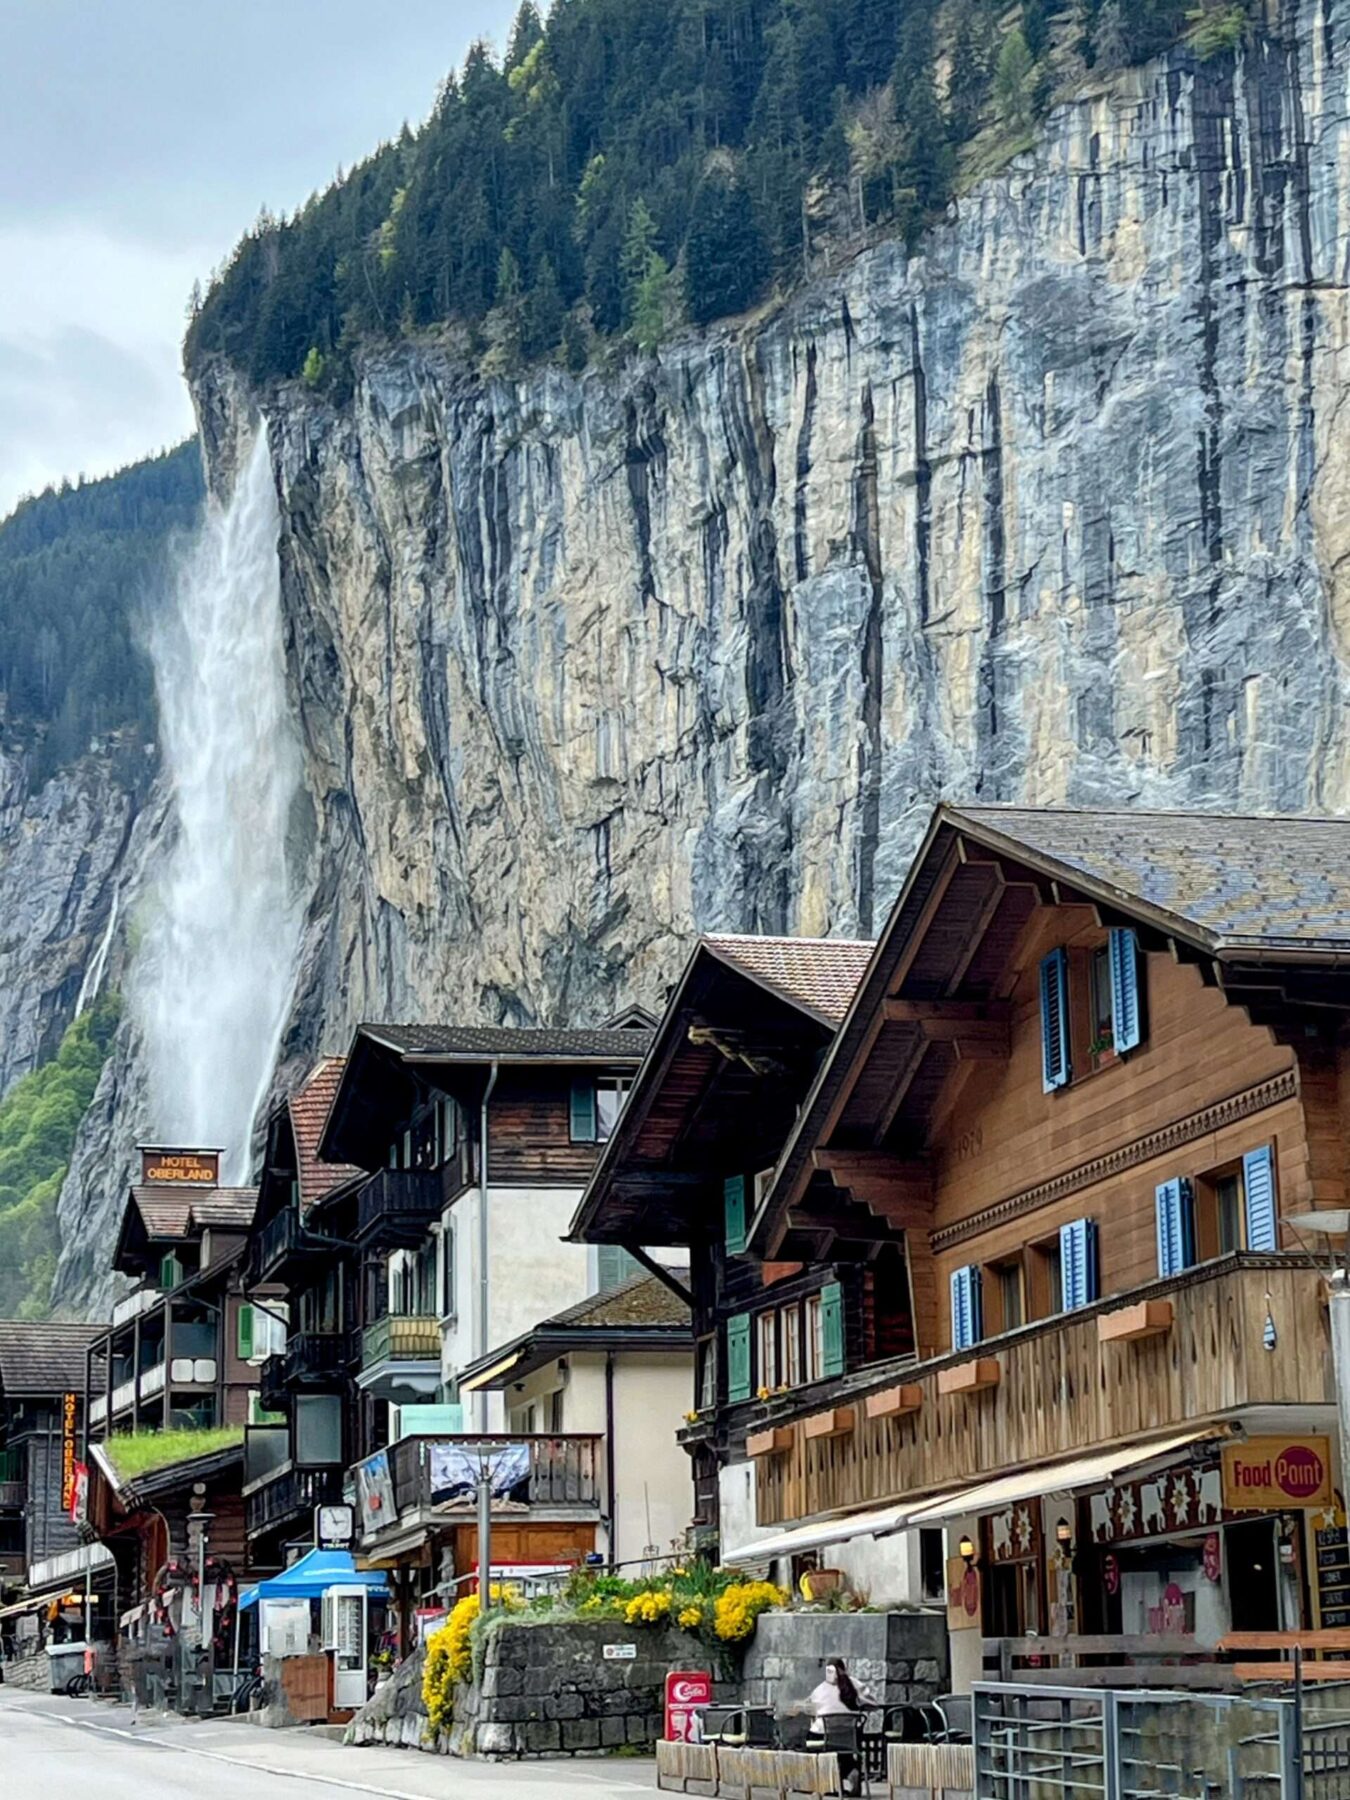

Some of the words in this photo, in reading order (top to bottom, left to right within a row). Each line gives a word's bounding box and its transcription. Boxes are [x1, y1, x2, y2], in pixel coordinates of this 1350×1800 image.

[161, 1156, 201, 1168] HOTEL
[147, 1167, 214, 1181] OBERLAND
[64, 1394, 75, 1437] HOTEL
[1233, 1459, 1272, 1488] Food
[1277, 1458, 1321, 1486] Point
